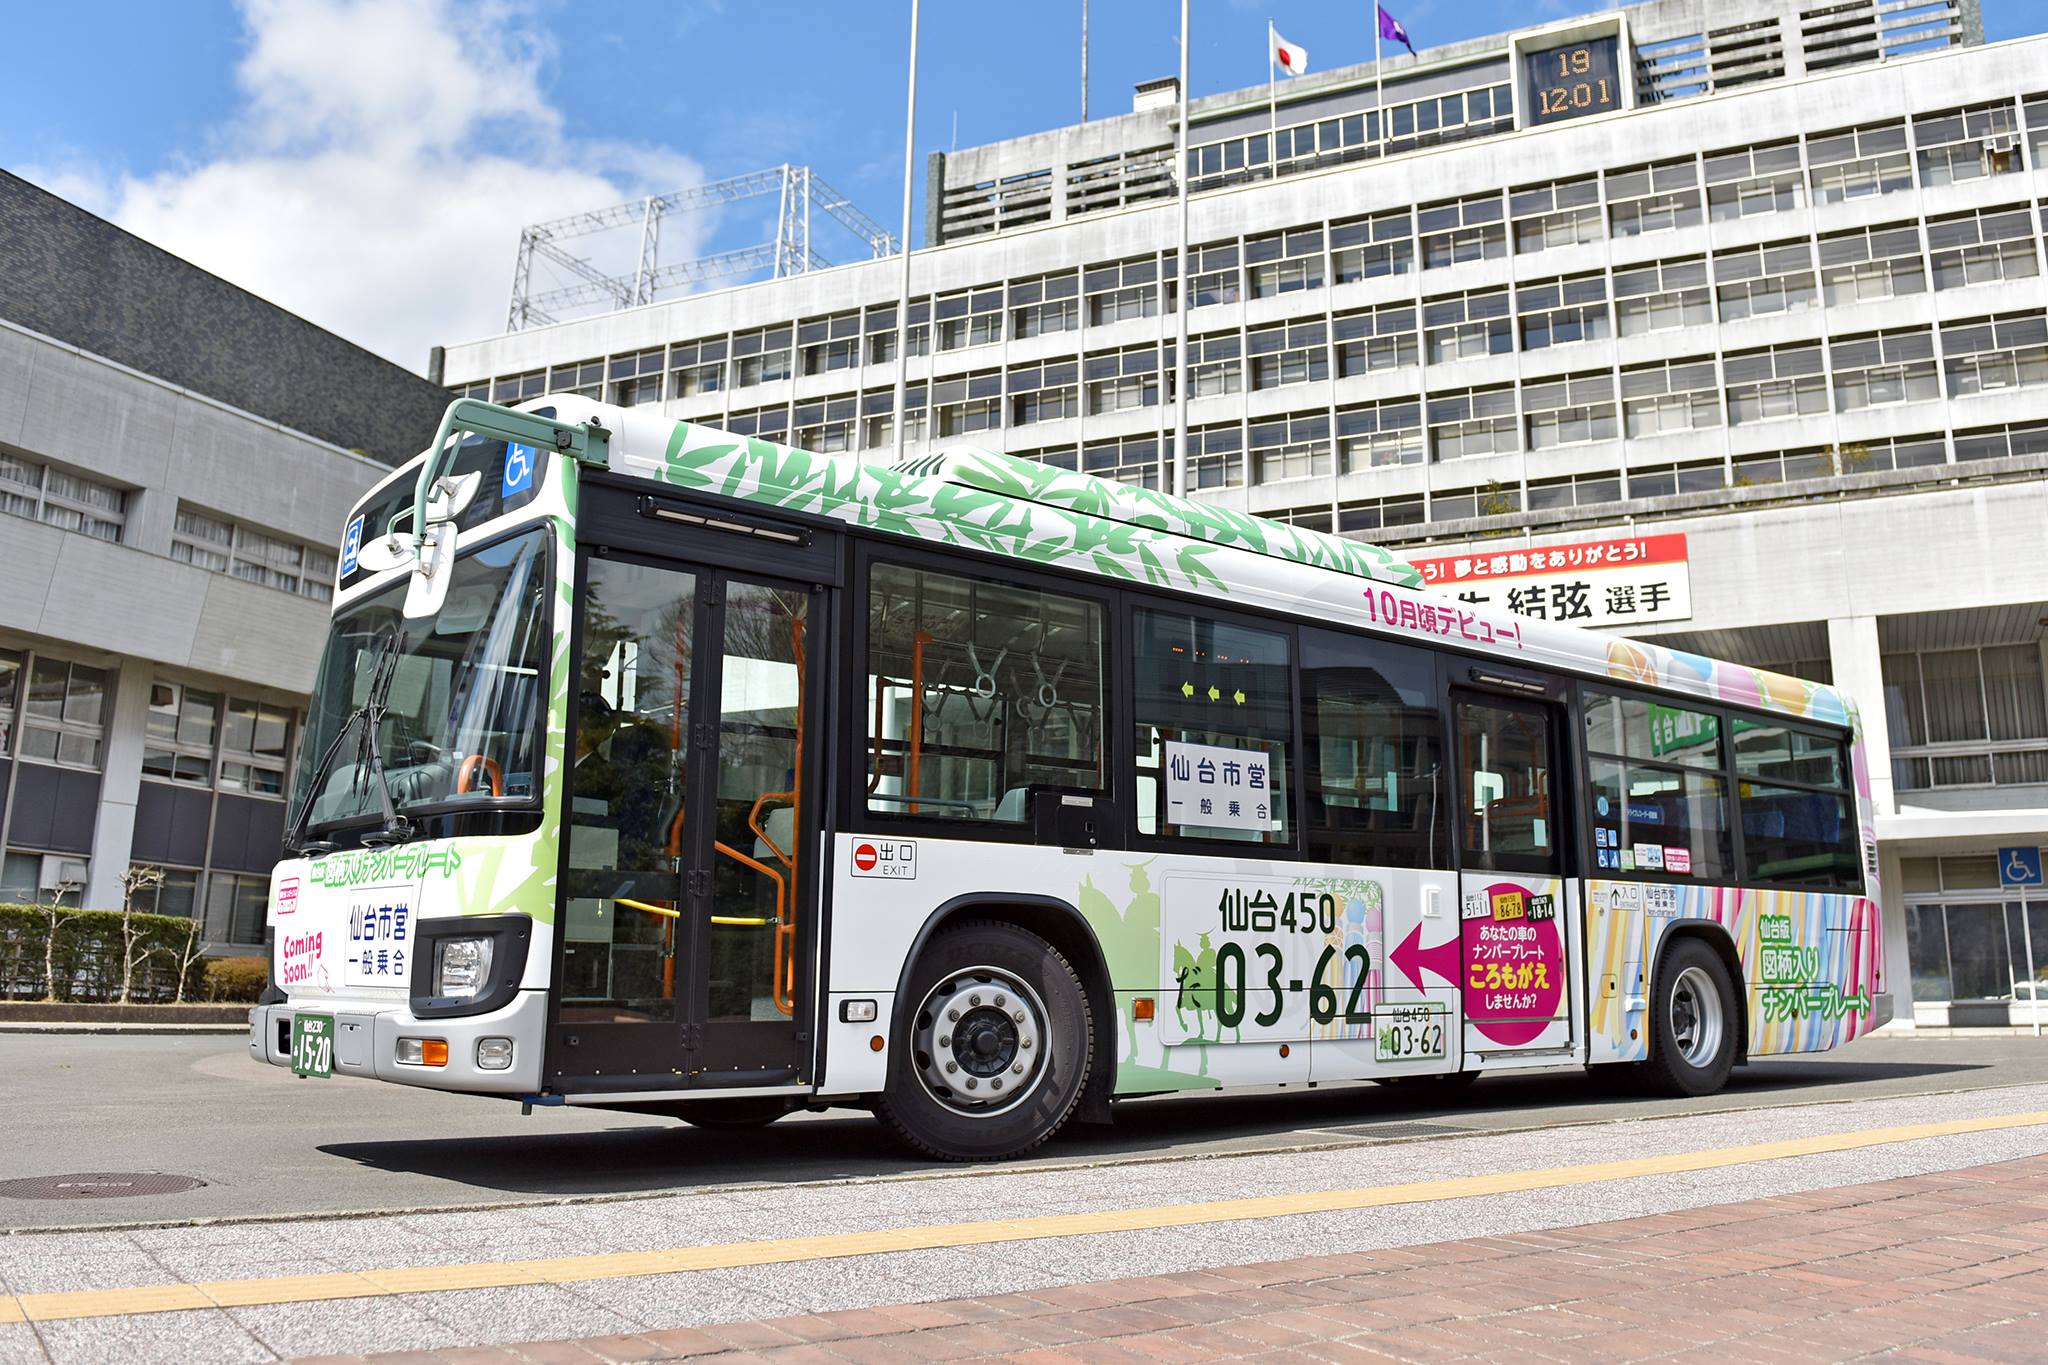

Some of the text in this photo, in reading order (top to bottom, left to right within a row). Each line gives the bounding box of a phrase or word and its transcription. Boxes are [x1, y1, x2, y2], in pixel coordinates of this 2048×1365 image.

[1559, 49, 1590, 77] 19
[1413, 562, 1445, 581] う!
[1605, 582, 1671, 615] 選手
[1363, 587, 1523, 649] 10月頃デビュー!
[1170, 753, 1266, 790] 仙台市営
[1171, 798, 1268, 820] 一般乗合
[880, 842, 913, 861] 出口
[882, 865, 908, 876] EXIT
[1622, 887, 1637, 899] 入口
[1646, 887, 1676, 901] 仙台市営
[349, 903, 409, 941] 仙台市営
[1218, 888, 1336, 934] 仙台450
[1480, 925, 1537, 942] あなたの車の
[1759, 914, 1792, 943] 仙台版
[283, 930, 323, 960] Coming
[1472, 943, 1545, 960] ナンバープレート
[283, 953, 314, 985] Soon!!
[348, 949, 405, 976] 一般乗合
[1470, 962, 1550, 989] ころもがえ
[1761, 946, 1820, 983] 図柄入り
[1175, 941, 1372, 1029] だ 03-62
[1391, 1007, 1430, 1023] 仙台450
[1485, 993, 1537, 1010] しませんか?
[1762, 983, 1871, 1023] ナンバープレート
[299, 1034, 331, 1073] 15-20
[1391, 1024, 1442, 1056] 03-62
